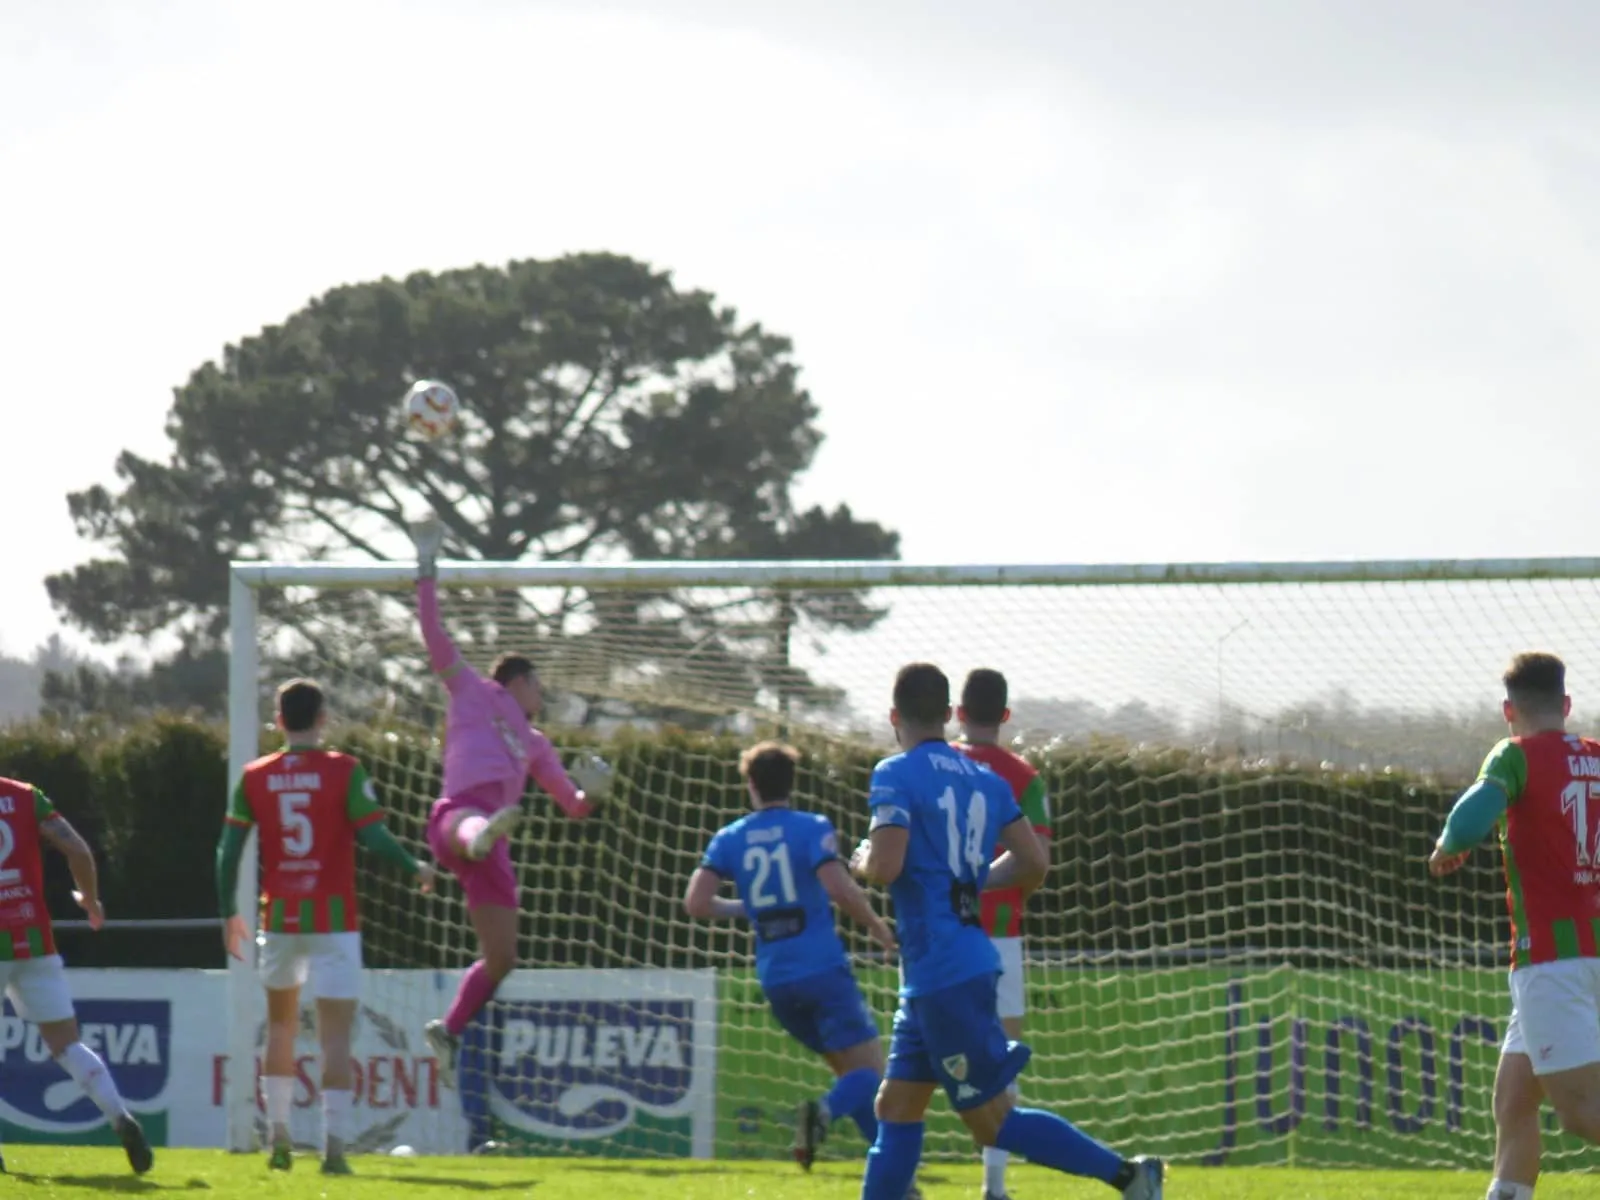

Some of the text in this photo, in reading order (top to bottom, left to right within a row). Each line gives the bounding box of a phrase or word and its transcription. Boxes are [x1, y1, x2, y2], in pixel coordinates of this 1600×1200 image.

[278, 793, 314, 857] 5
[743, 842, 797, 907] 21
[0, 1016, 161, 1065] PUEVA
[501, 1019, 684, 1067] PULEVA
